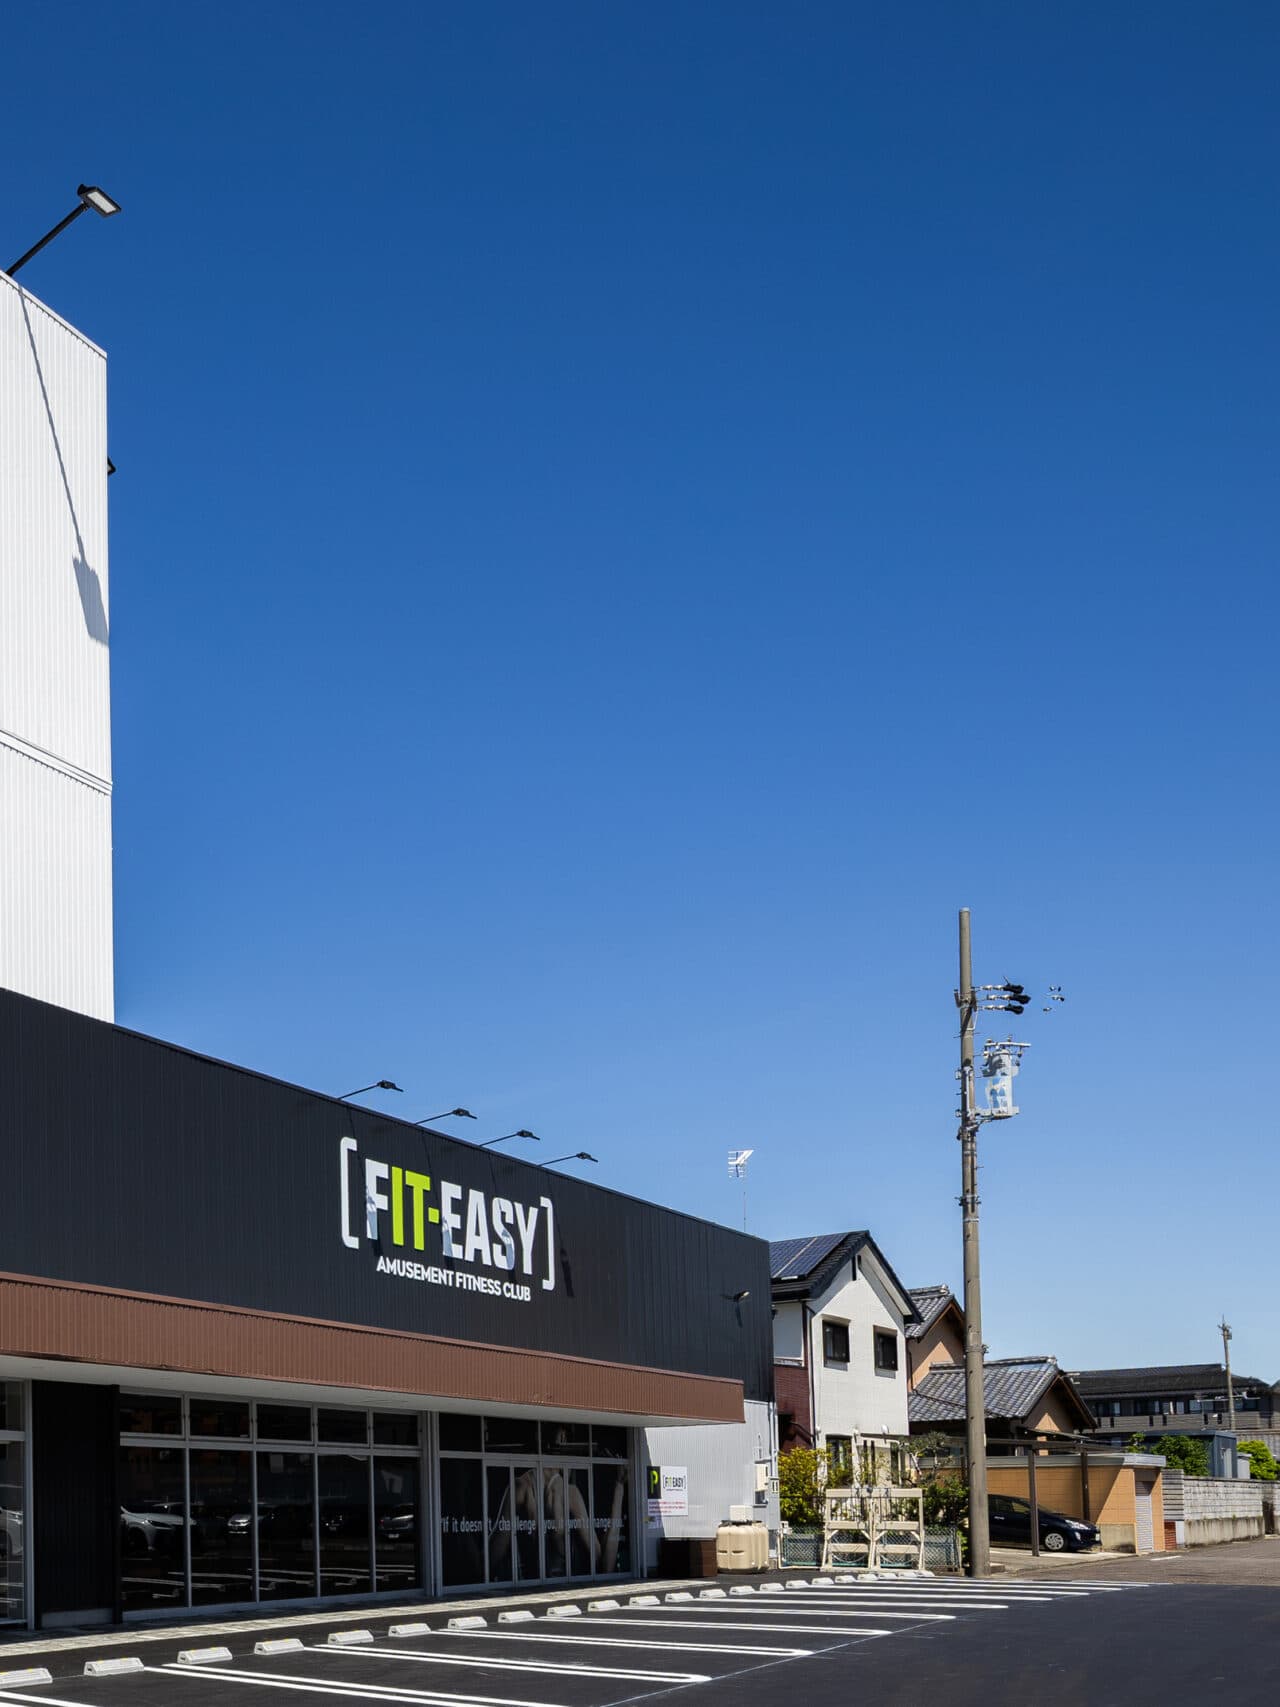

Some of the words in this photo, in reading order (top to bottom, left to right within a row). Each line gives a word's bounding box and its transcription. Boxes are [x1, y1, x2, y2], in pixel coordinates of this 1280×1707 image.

[376, 1256, 454, 1287] AMUSEMENT
[455, 1271, 502, 1297] FITNESS
[503, 1282, 532, 1302] CLUB
